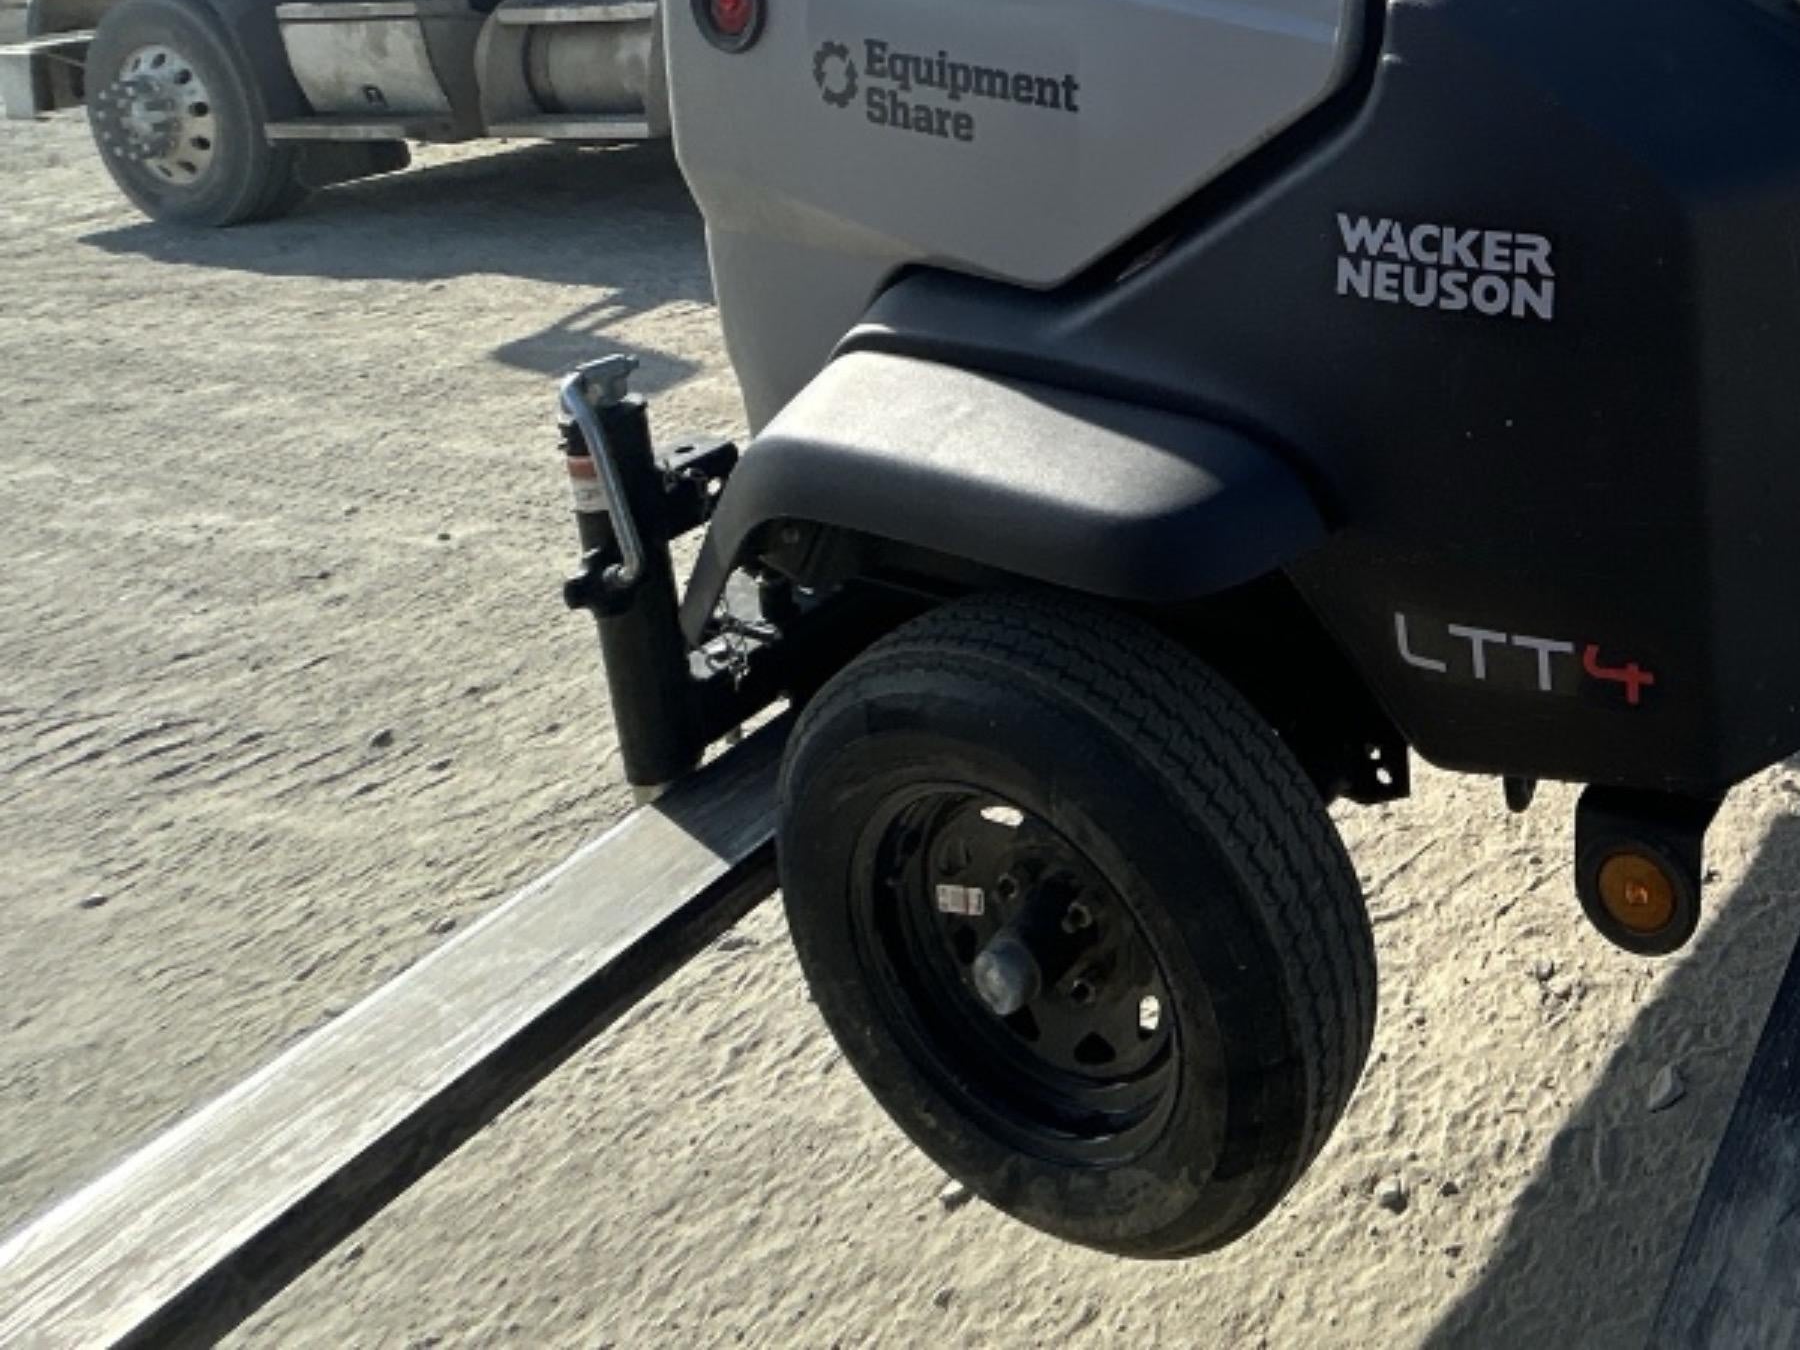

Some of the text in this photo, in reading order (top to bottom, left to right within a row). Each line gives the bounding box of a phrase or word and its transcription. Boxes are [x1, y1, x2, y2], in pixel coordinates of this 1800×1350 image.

[863, 38, 1080, 113] Equipment
[865, 85, 974, 142] Share
[1337, 212, 1555, 277] WACKER
[1336, 255, 1555, 320] NEUSON
[1395, 611, 1654, 704] LTT4
